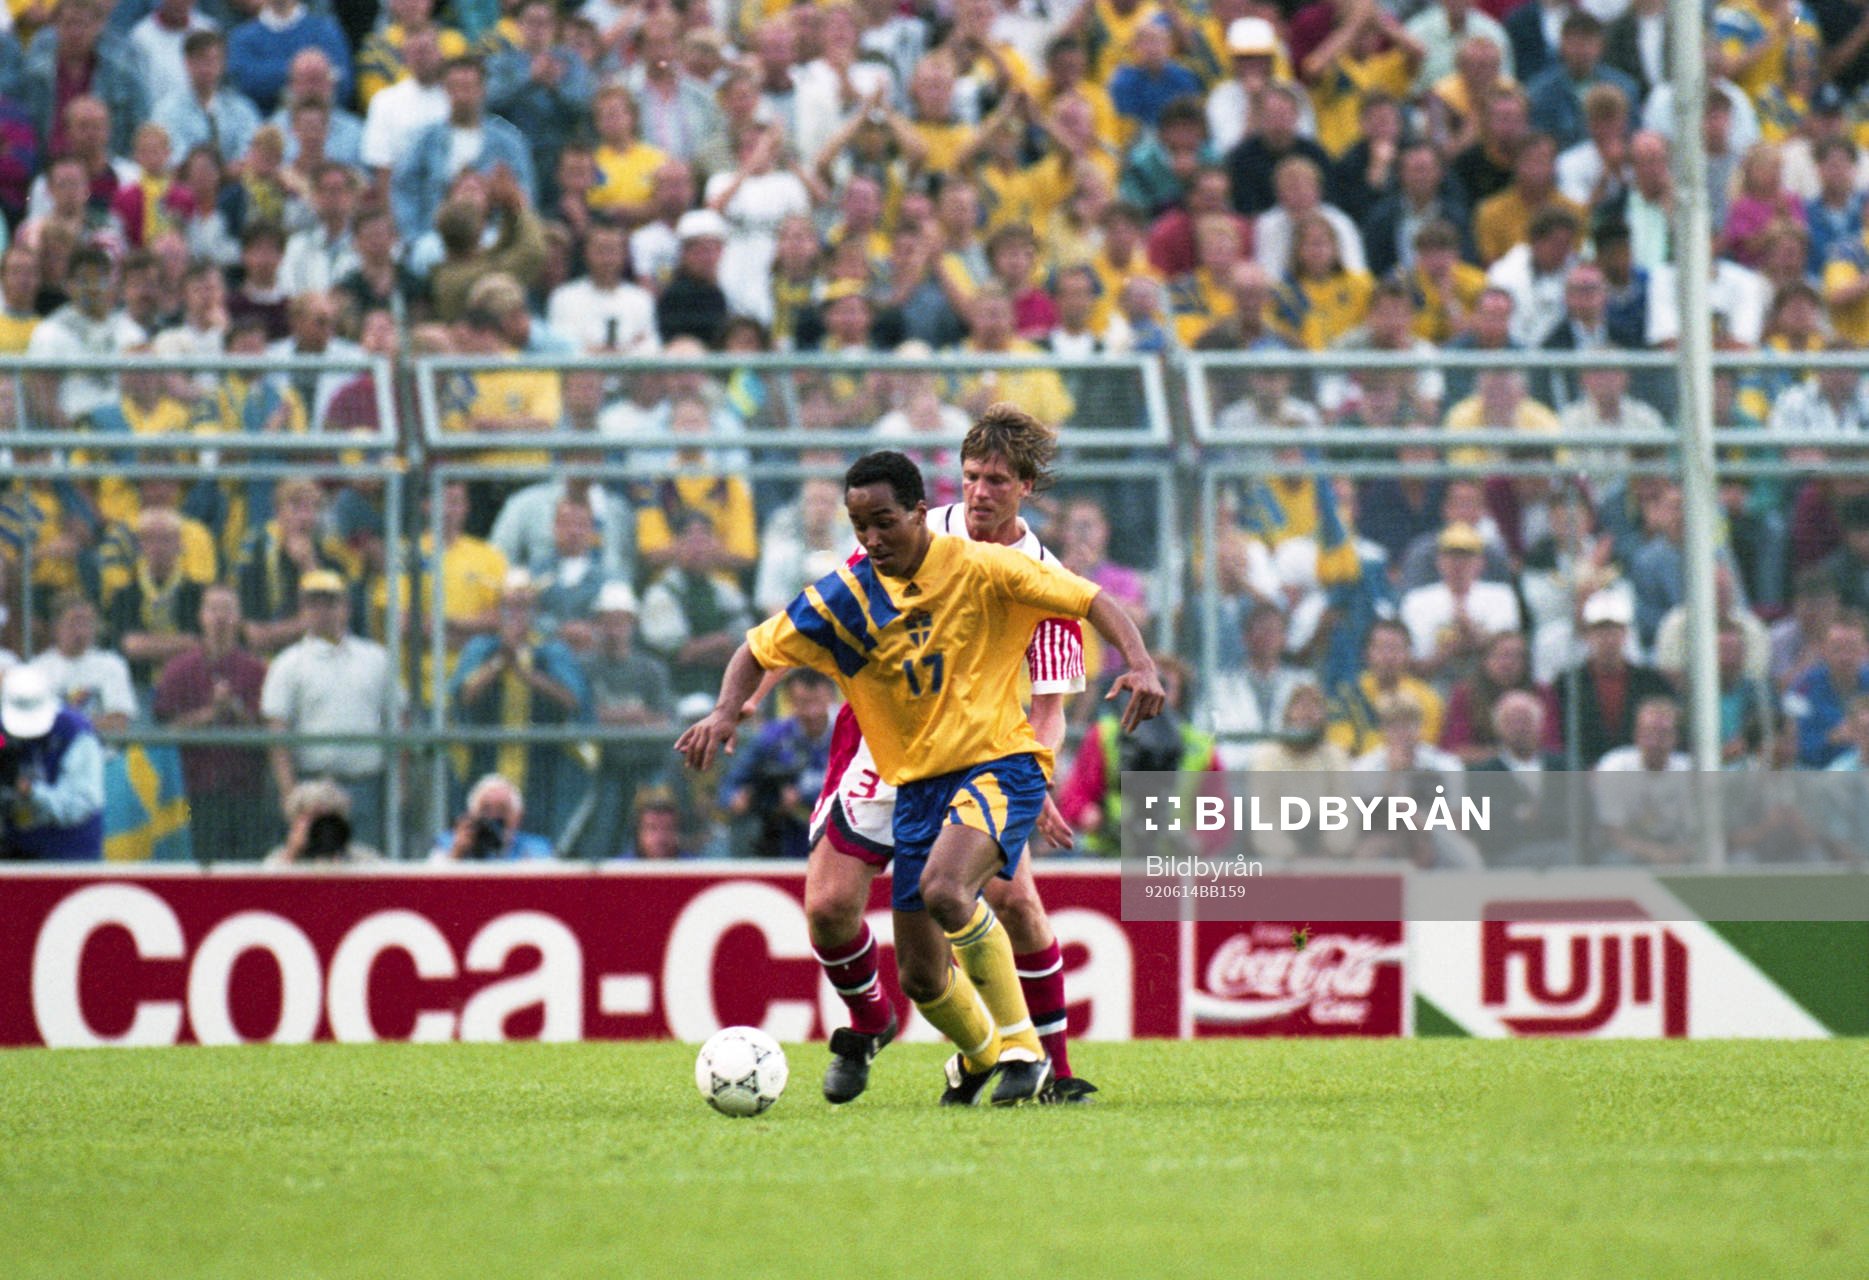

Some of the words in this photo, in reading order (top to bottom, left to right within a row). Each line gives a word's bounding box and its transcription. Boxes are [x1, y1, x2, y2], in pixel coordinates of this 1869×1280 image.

[903, 652, 944, 696] 17
[848, 769, 881, 798] 3
[31, 882, 1133, 1048] Coca-Ca
